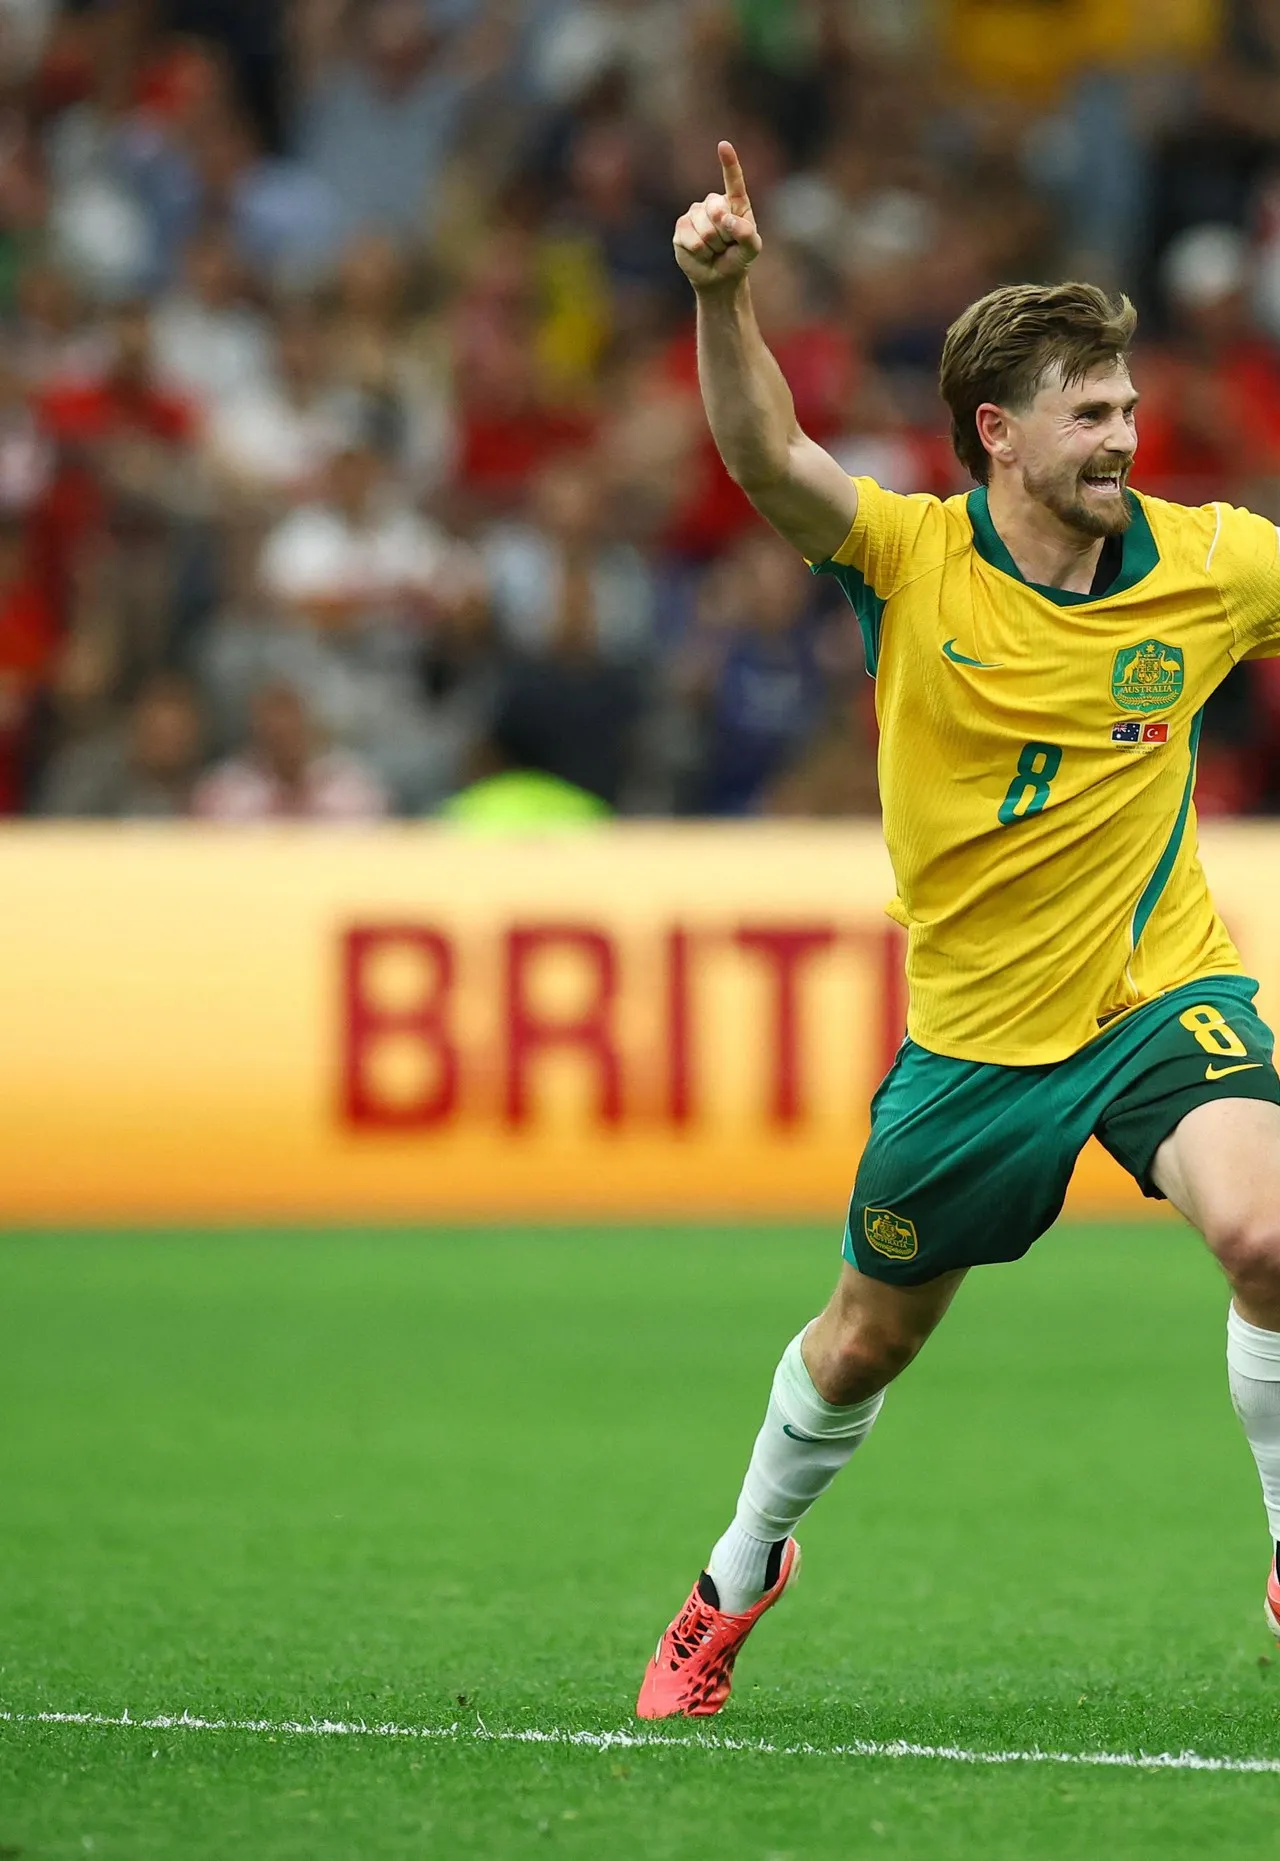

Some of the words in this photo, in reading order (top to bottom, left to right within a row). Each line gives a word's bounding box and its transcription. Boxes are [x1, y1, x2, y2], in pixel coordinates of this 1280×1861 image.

[1123, 685, 1172, 693] AUSTRALIA
[997, 741, 1063, 826] 8
[1179, 1004, 1248, 1057] 8
